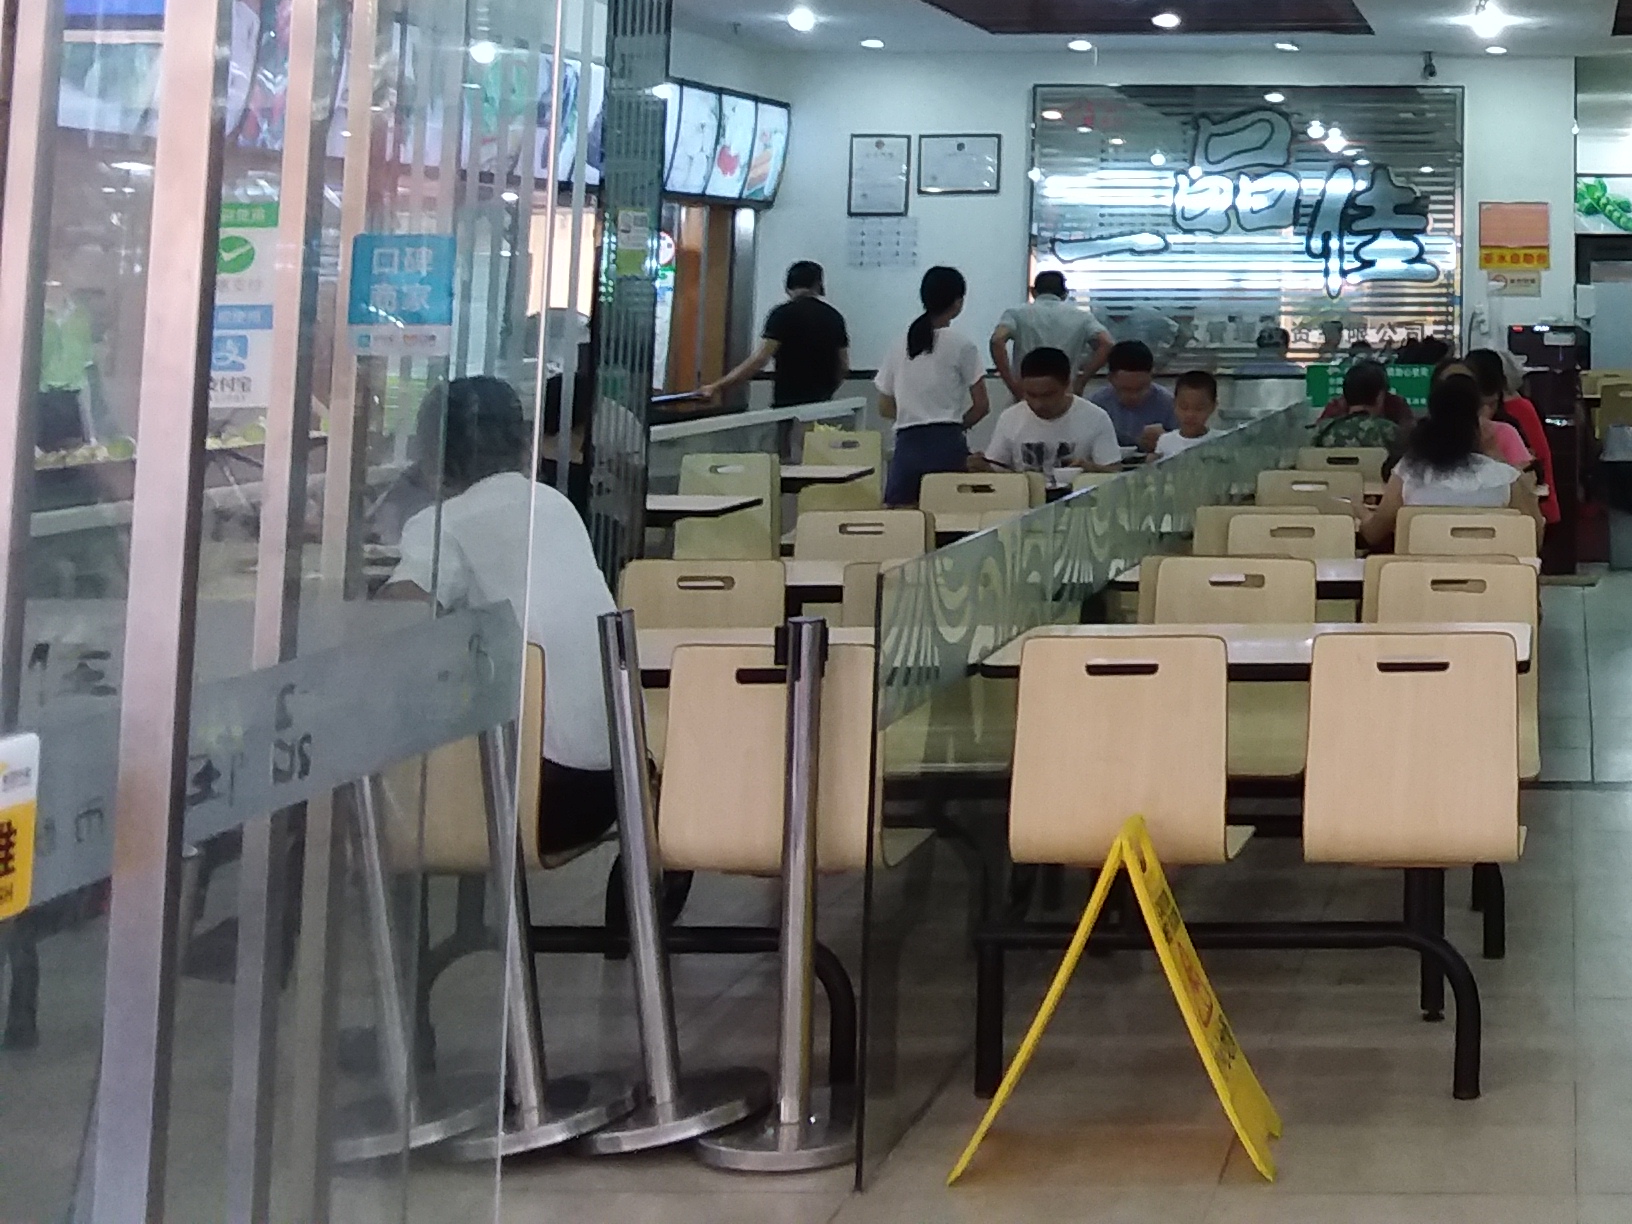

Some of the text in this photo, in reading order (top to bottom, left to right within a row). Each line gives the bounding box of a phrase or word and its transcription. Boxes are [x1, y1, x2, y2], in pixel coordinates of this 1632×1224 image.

[1050, 107, 1441, 300] 一品佳
[372, 246, 433, 276] 口碑
[369, 282, 432, 314] 商家
